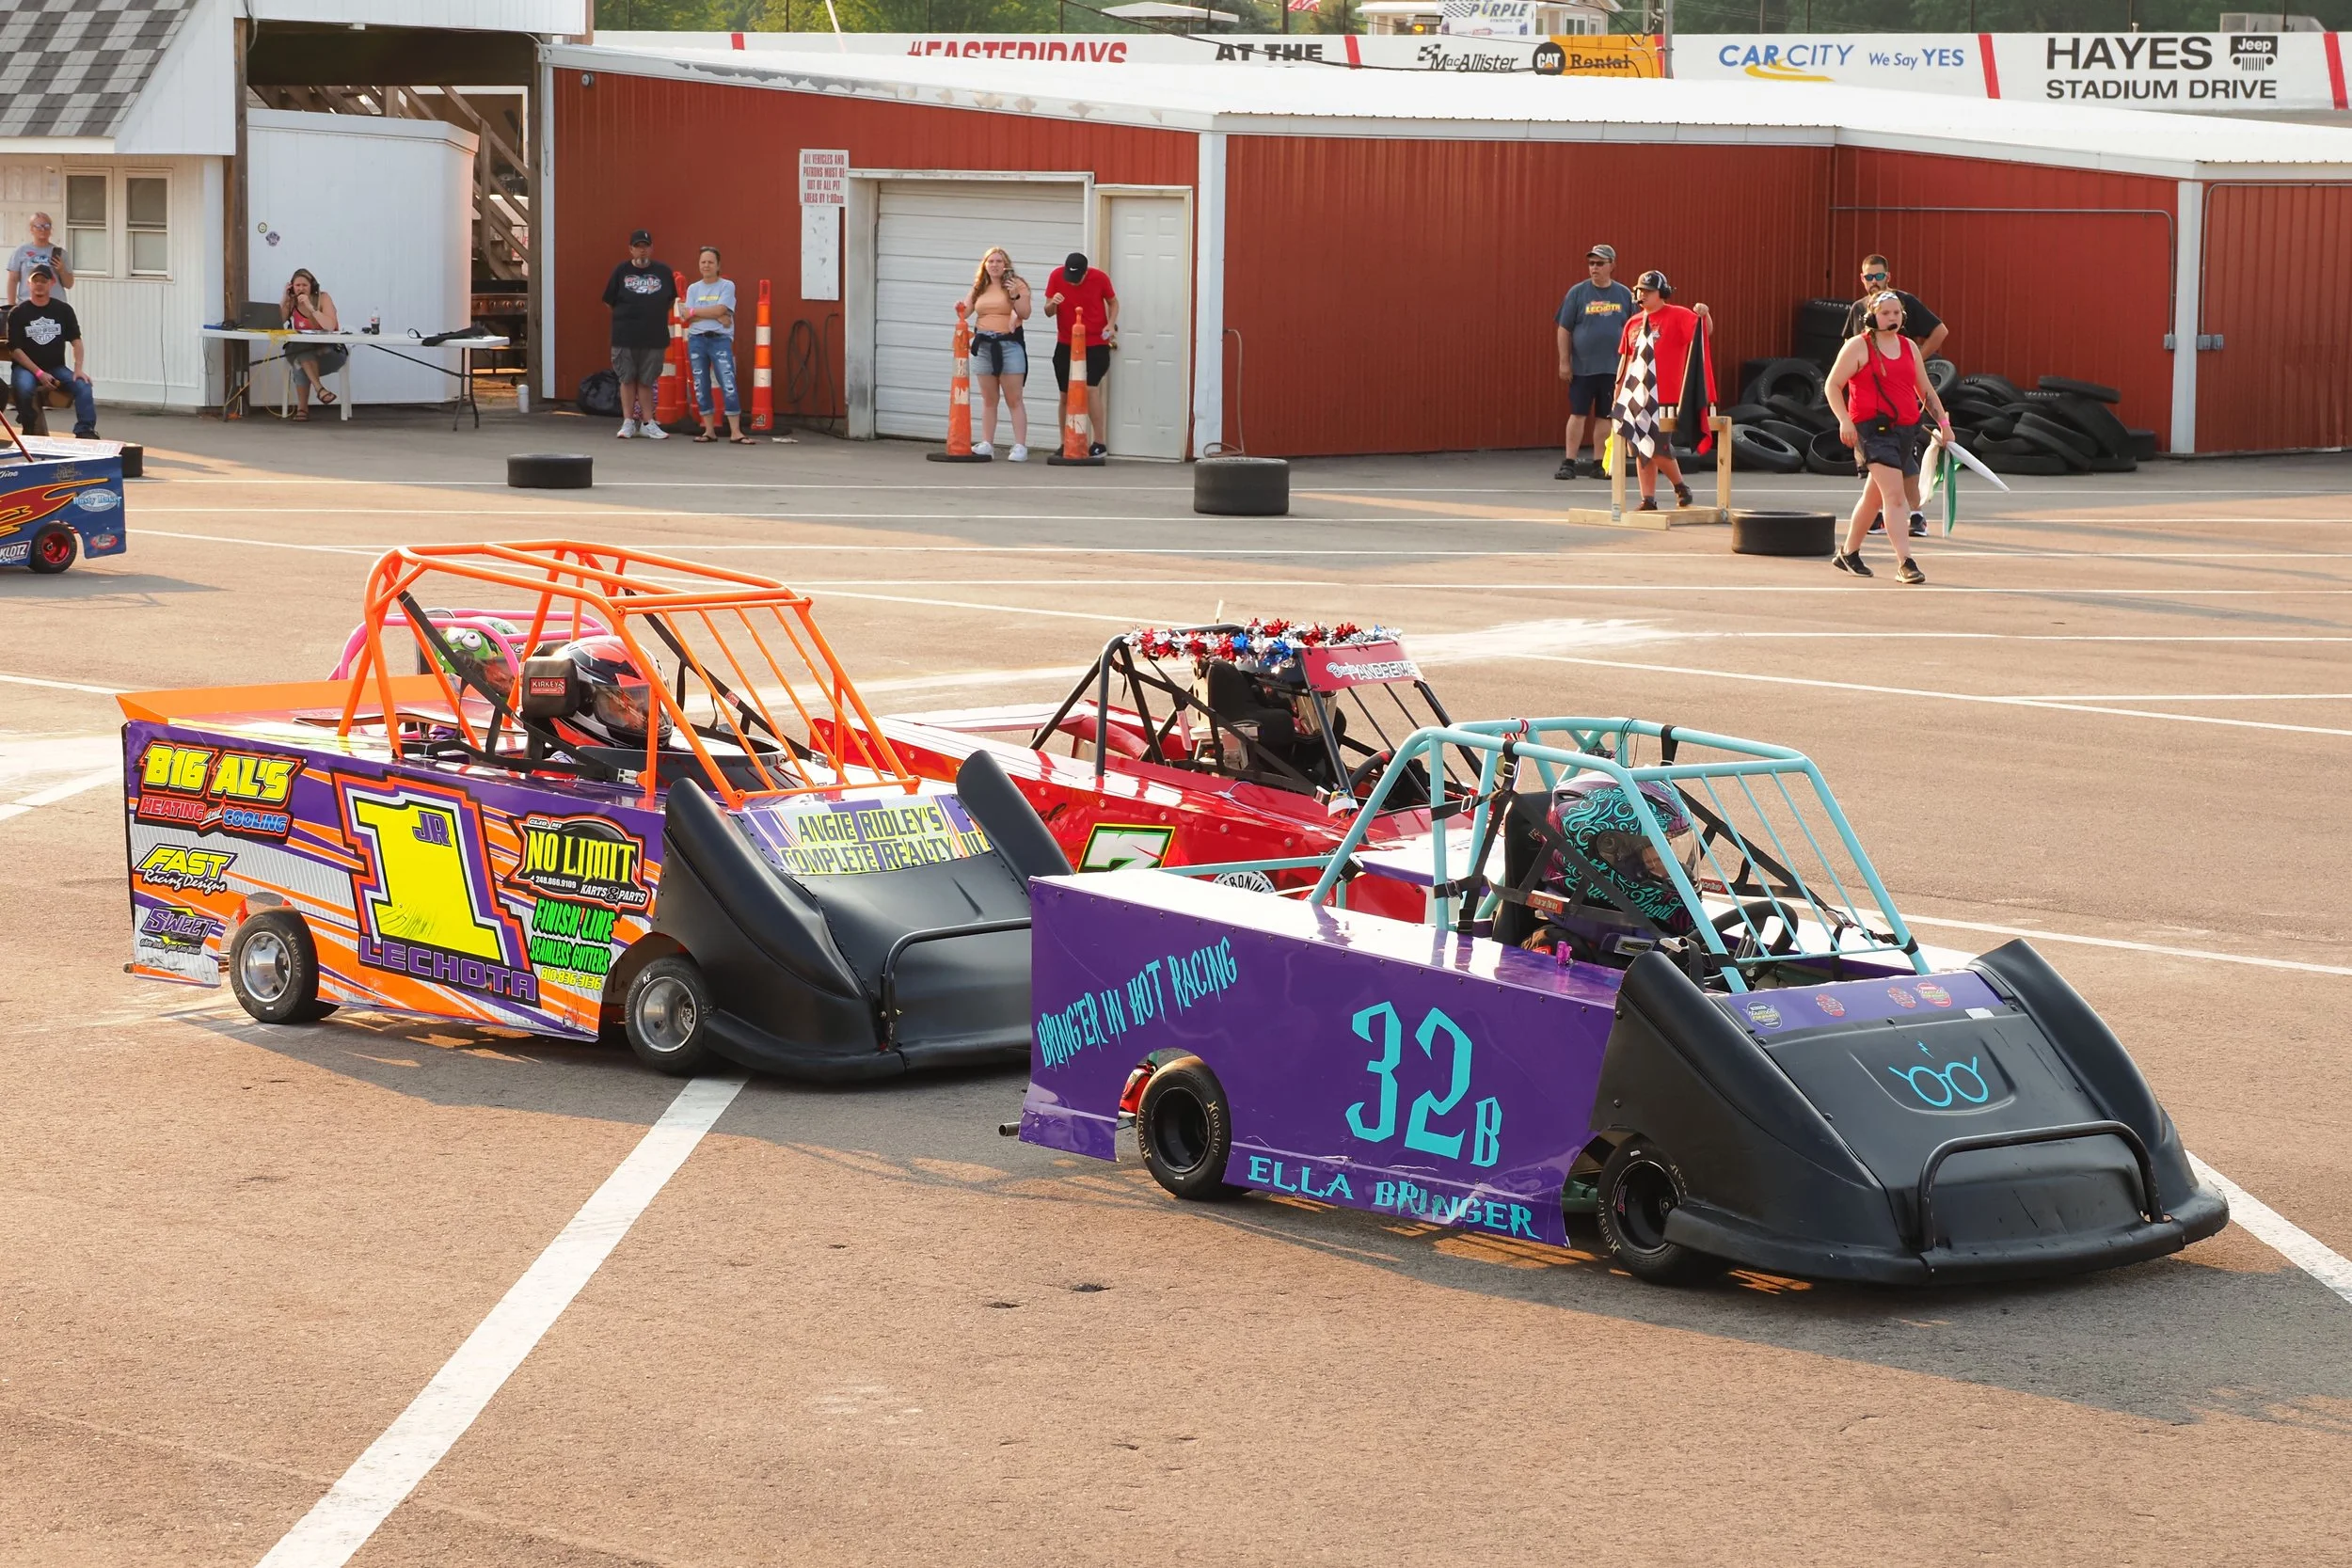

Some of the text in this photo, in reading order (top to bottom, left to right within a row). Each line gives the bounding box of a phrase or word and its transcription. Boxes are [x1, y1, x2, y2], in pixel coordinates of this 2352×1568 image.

[1215, 43, 1323, 61] AT THE
[1429, 53, 1518, 72] MacAllister
[1536, 52, 1629, 70] CAT Rental
[1718, 44, 1964, 71] CAR CITY We Say YES
[2045, 36, 2213, 71] HAYES
[2237, 38, 2272, 53] Jeep
[2045, 79, 2277, 100] STADIUM DRIVE
[824, 166, 837, 178] MUST
[143, 744, 295, 802] BIG AL'S
[140, 796, 206, 821] HEATING
[223, 809, 289, 832] COOLING
[412, 811, 453, 847] JR
[798, 806, 945, 844] ANGIE RIDLEY'S
[139, 847, 231, 879] FAST
[523, 830, 637, 883] NO LIMIT
[782, 844, 878, 874] COMPLETE
[881, 836, 954, 868] REALTY
[143, 868, 227, 895] Racing Designs
[355, 800, 502, 962] 1
[141, 908, 219, 938] SWEET
[532, 897, 616, 943] FINISH LINE
[358, 935, 537, 1003] LECHOTA
[530, 935, 612, 975] SEAMLESS GUTTERS
[541, 967, 603, 990] 810-836-3136
[643, 972, 651, 985] RF
[1100, 989, 1128, 1046] IN
[1126, 958, 1167, 1026] HOT
[1167, 935, 1238, 1017] RACING
[1206, 1100, 1223, 1158] Hoosier
[1247, 1155, 1543, 1240] ELLA BRINGER
